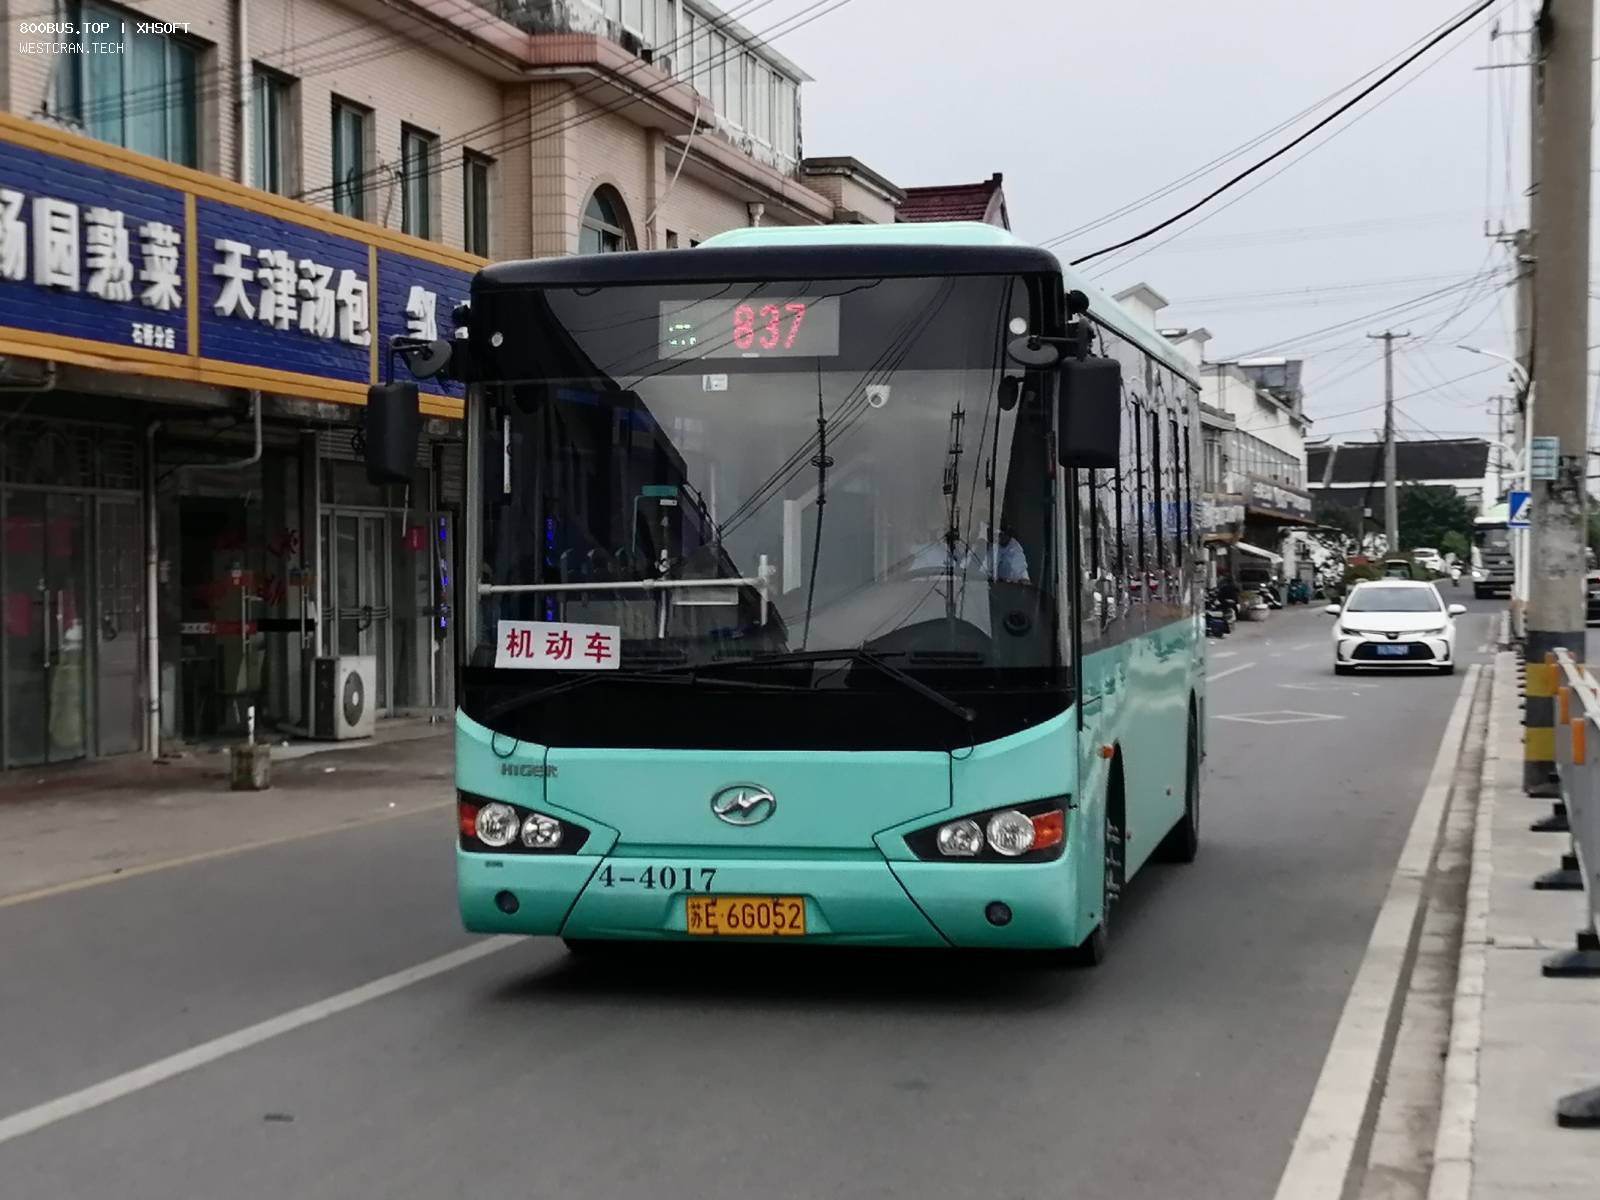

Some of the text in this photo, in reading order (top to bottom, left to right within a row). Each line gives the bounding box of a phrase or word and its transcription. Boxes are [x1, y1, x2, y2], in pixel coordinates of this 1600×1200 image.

[213, 238, 371, 347] 天津汤包
[733, 303, 806, 349] 837
[506, 627, 612, 664] 机动车
[501, 763, 558, 778] HIGER
[599, 864, 718, 893] 4-4017
